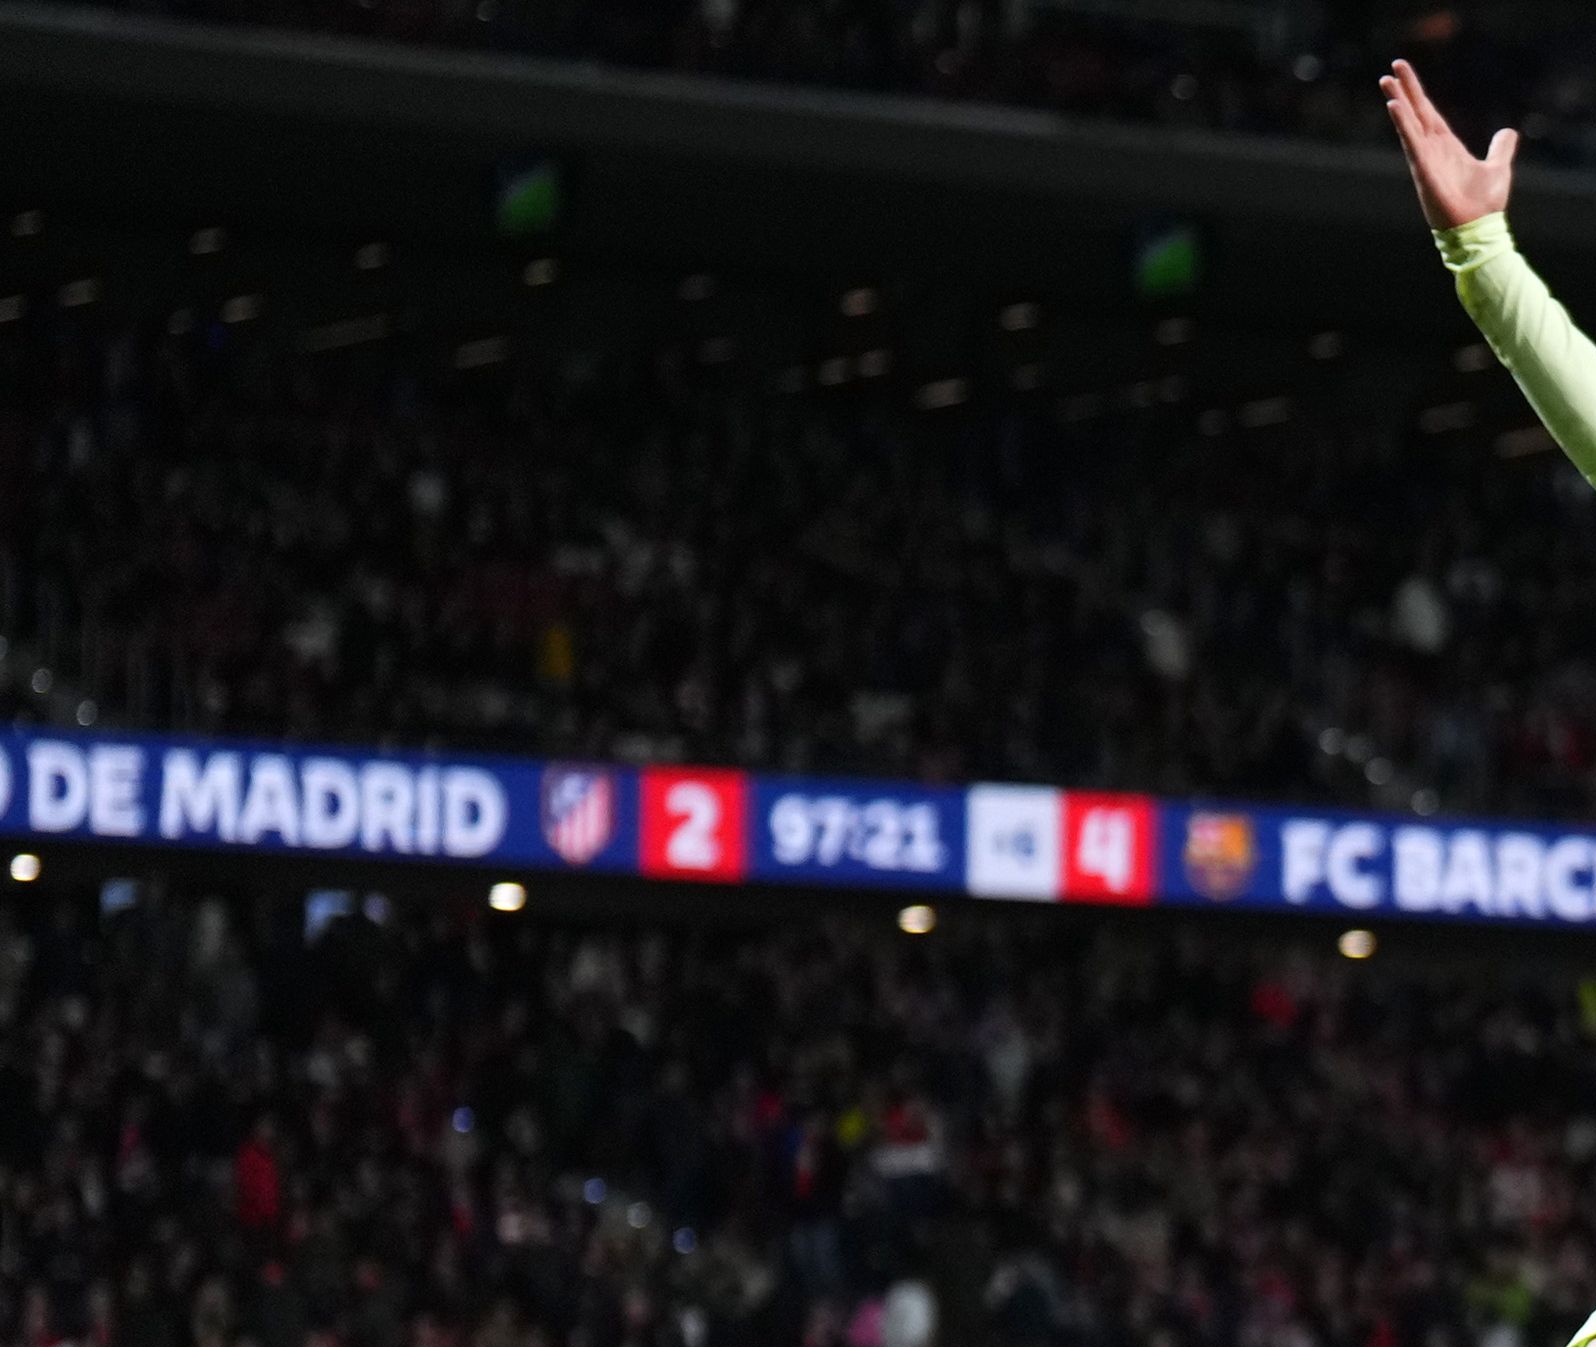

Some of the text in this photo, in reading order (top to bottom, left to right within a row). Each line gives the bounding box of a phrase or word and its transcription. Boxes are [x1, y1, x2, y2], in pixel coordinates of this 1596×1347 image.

[27, 740, 146, 837] DE
[160, 753, 509, 858] MADRID
[666, 780, 721, 870] 2
[769, 792, 948, 873] 97:21
[1079, 806, 1136, 894] 4
[1281, 820, 1387, 910] FC
